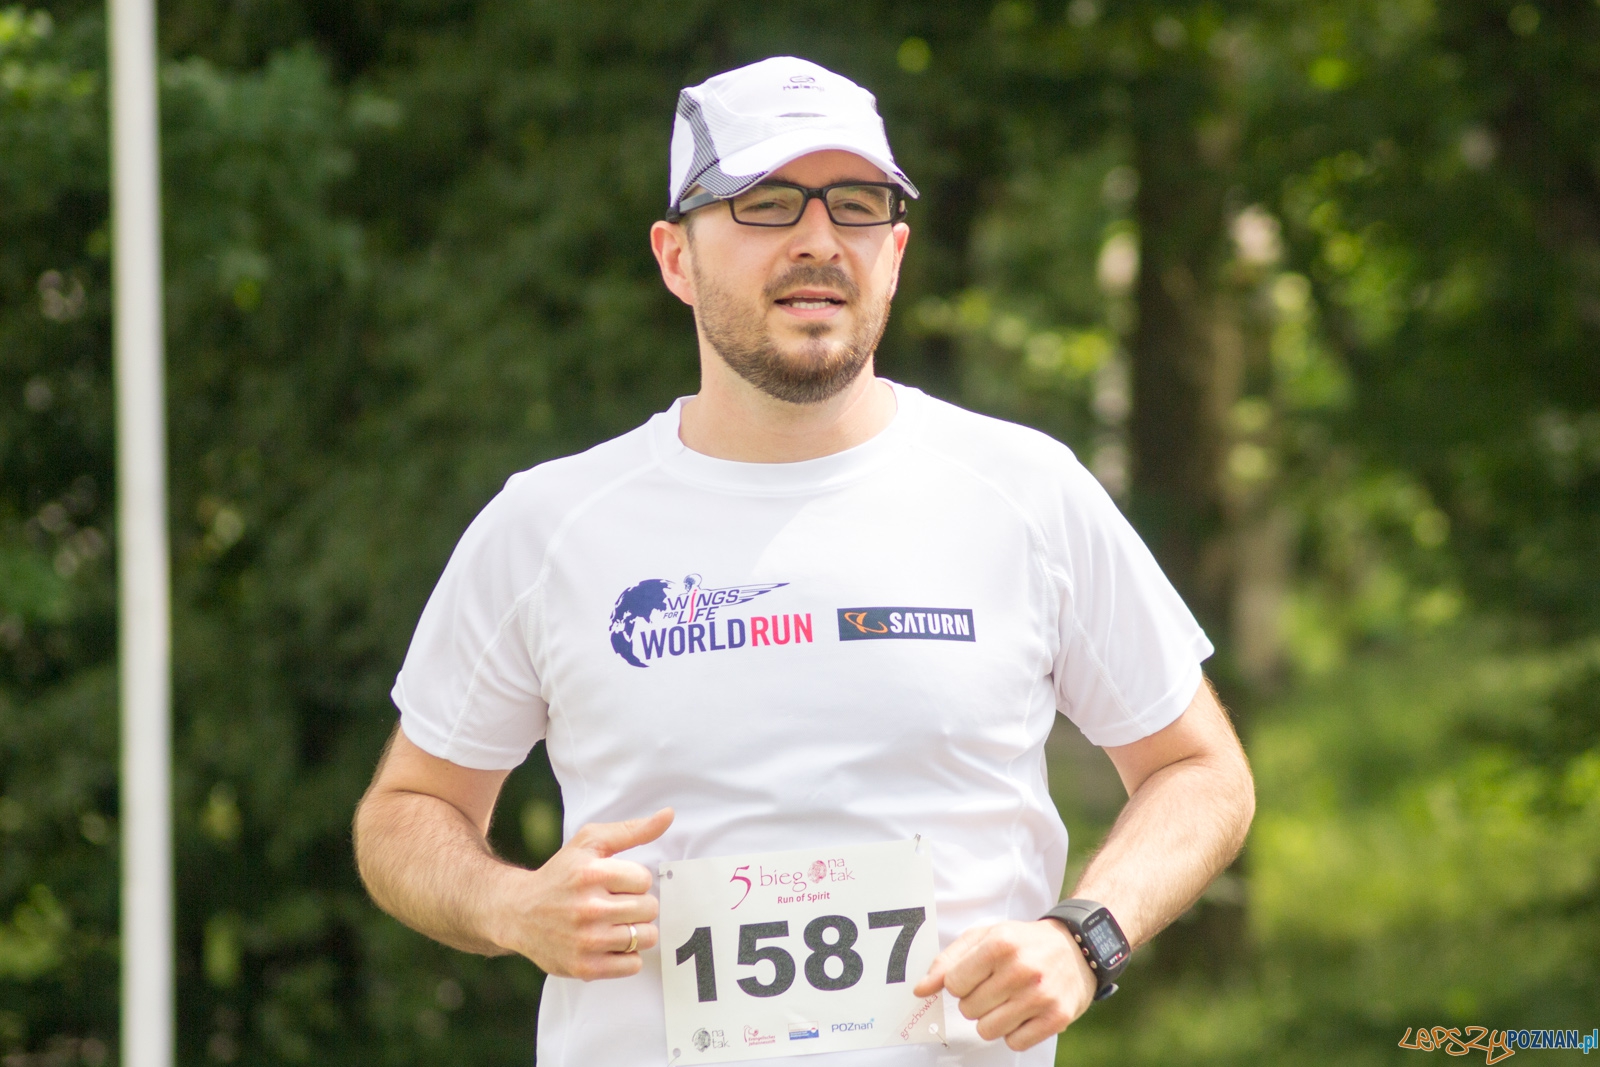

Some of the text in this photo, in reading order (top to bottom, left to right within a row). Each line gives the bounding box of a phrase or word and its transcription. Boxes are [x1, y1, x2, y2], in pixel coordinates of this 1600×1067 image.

[667, 589, 740, 611] WINGS
[663, 605, 720, 624] FOR LIFE
[889, 612, 970, 636] SATURN
[640, 613, 813, 660] WORLD RUN
[828, 858, 845, 868] na
[830, 867, 856, 882] tak
[729, 865, 807, 910] 5 bieg
[777, 891, 830, 904] Run of Spirit
[676, 906, 926, 1003] 1587
